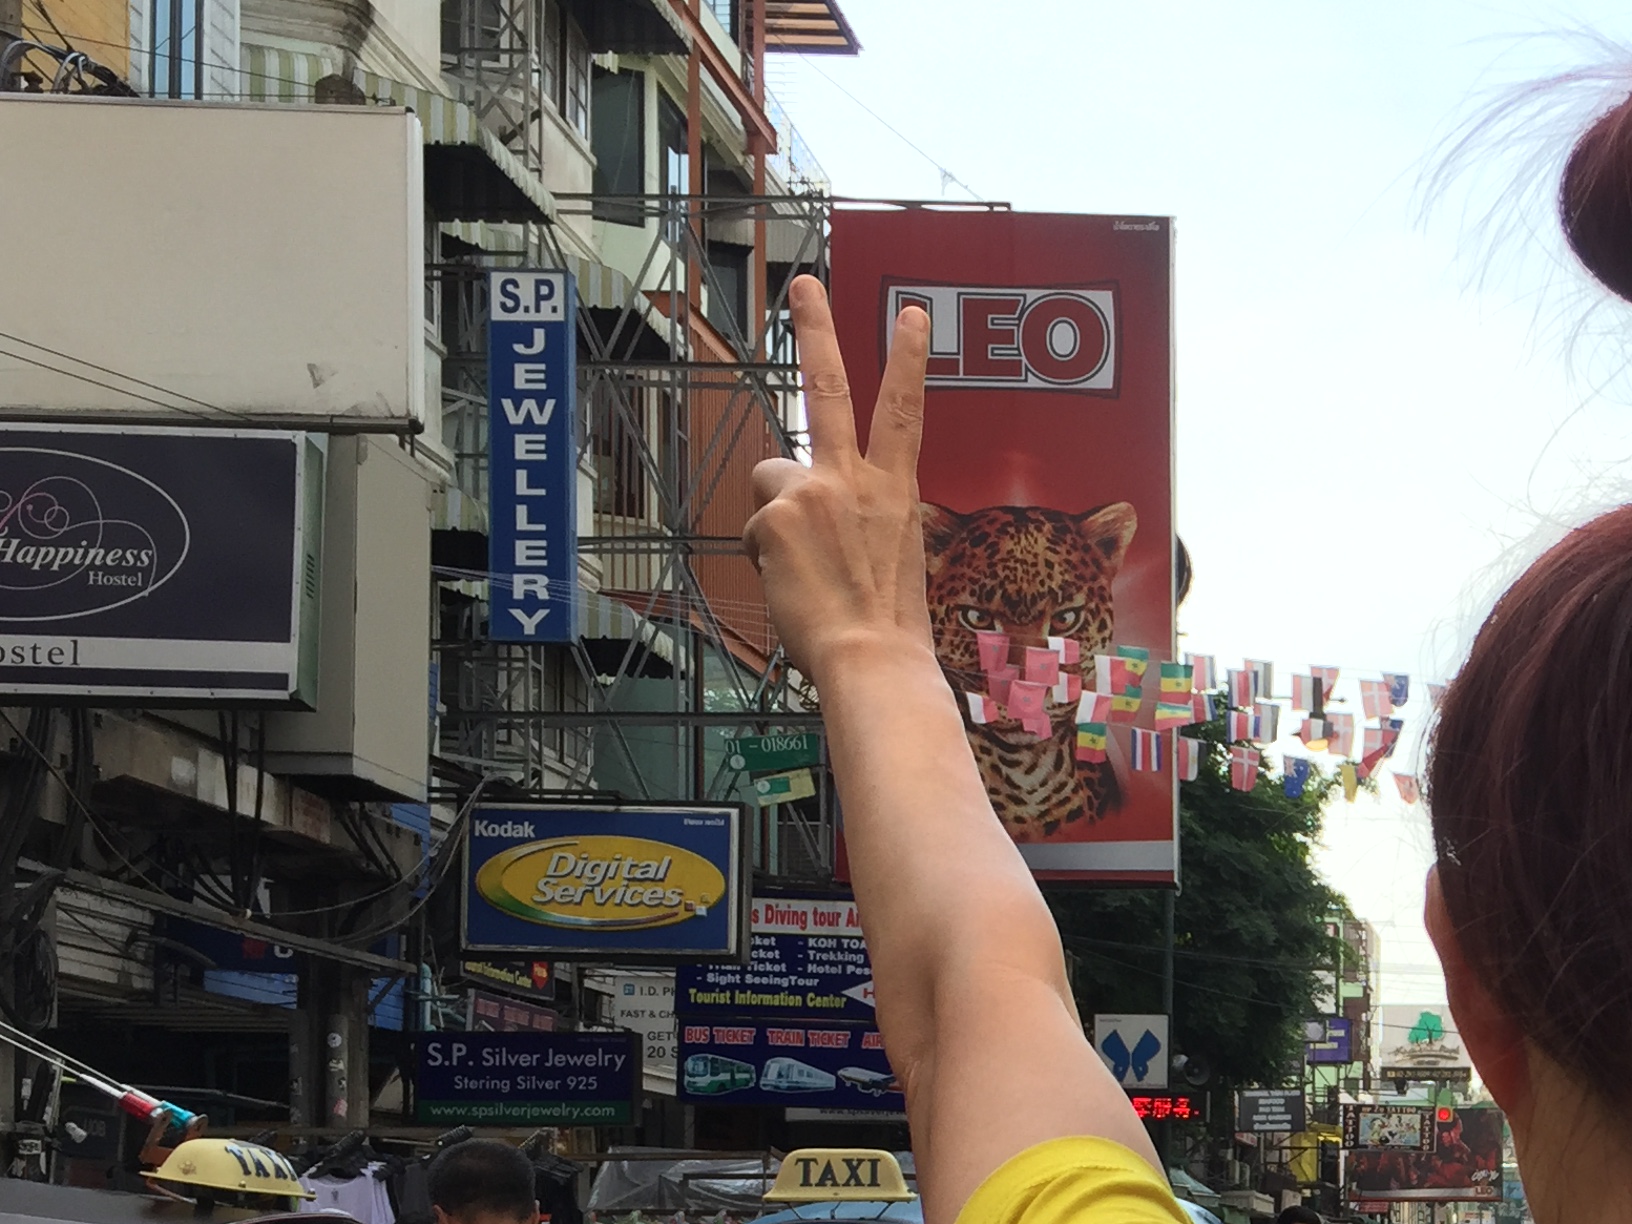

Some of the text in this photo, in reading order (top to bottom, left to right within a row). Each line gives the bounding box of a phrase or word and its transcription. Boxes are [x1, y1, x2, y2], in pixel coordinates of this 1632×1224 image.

[500, 278, 558, 314] S.P.
[501, 327, 557, 636] JEWELLERY
[0, 538, 153, 571] Happiness
[88, 571, 143, 586] Hostel
[474, 819, 536, 839] Kodak
[546, 852, 672, 886] Digital
[532, 877, 685, 906] Services
[764, 903, 807, 931] Diving
[812, 906, 841, 928] tour
[808, 937, 837, 948] KOH
[808, 951, 865, 964] Trekking
[706, 972, 741, 984] Sight
[689, 988, 731, 1004] Tourist
[734, 990, 803, 1007] Information
[806, 993, 848, 1009] Center
[620, 1009, 646, 1019] FAST
[684, 1026, 710, 1044] BUS
[712, 1027, 756, 1045] TICKET
[767, 1028, 805, 1047] TRAIN
[807, 1029, 851, 1048] TICKET
[427, 1042, 626, 1072] S.P. Silver Jewelry
[516, 1076, 562, 1090] Silver
[566, 1076, 598, 1090] 925
[430, 1103, 616, 1119] www.spsilverjewelry.com
[795, 1158, 881, 1187] TAXI
